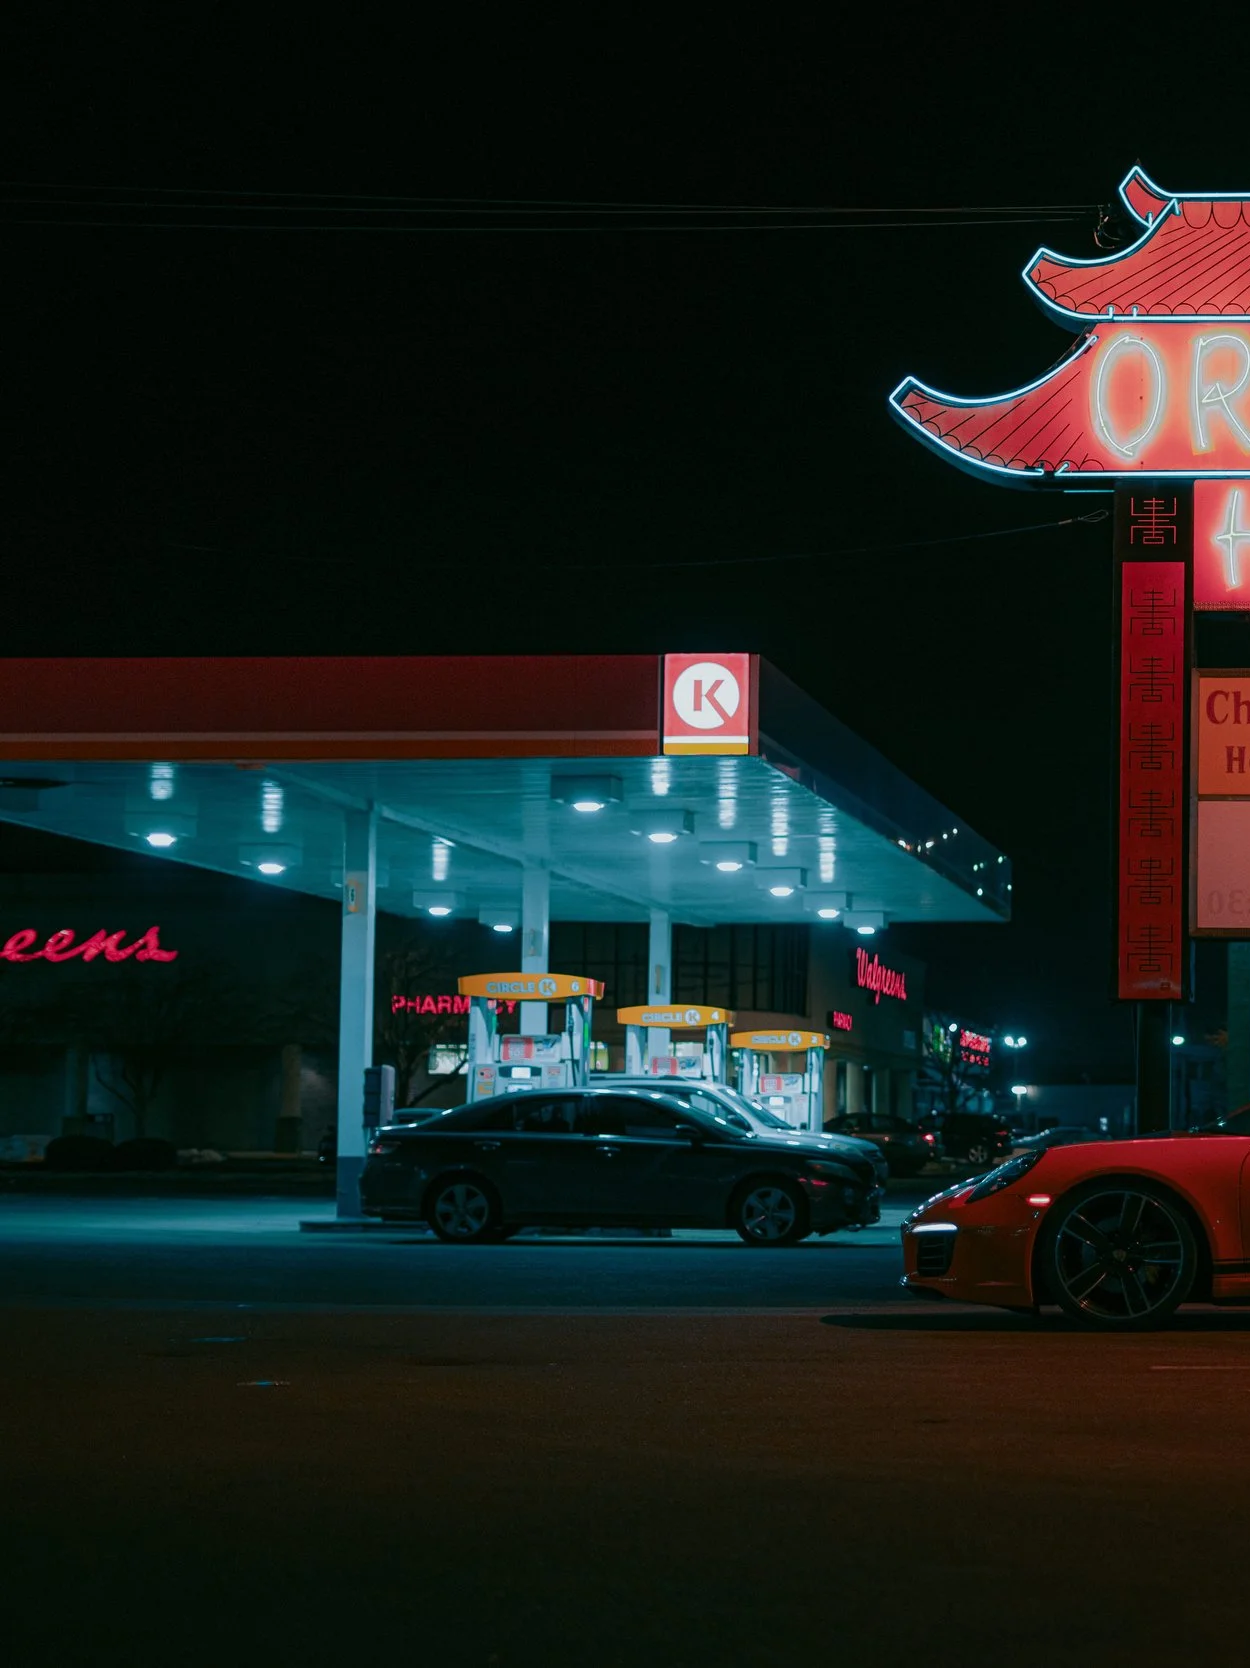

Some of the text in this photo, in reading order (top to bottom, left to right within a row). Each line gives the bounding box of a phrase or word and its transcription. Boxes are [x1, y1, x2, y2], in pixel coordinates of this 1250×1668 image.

[486, 981, 535, 993] CIRCLE
[571, 981, 580, 992] 6
[856, 947, 907, 1004] Walgreens
